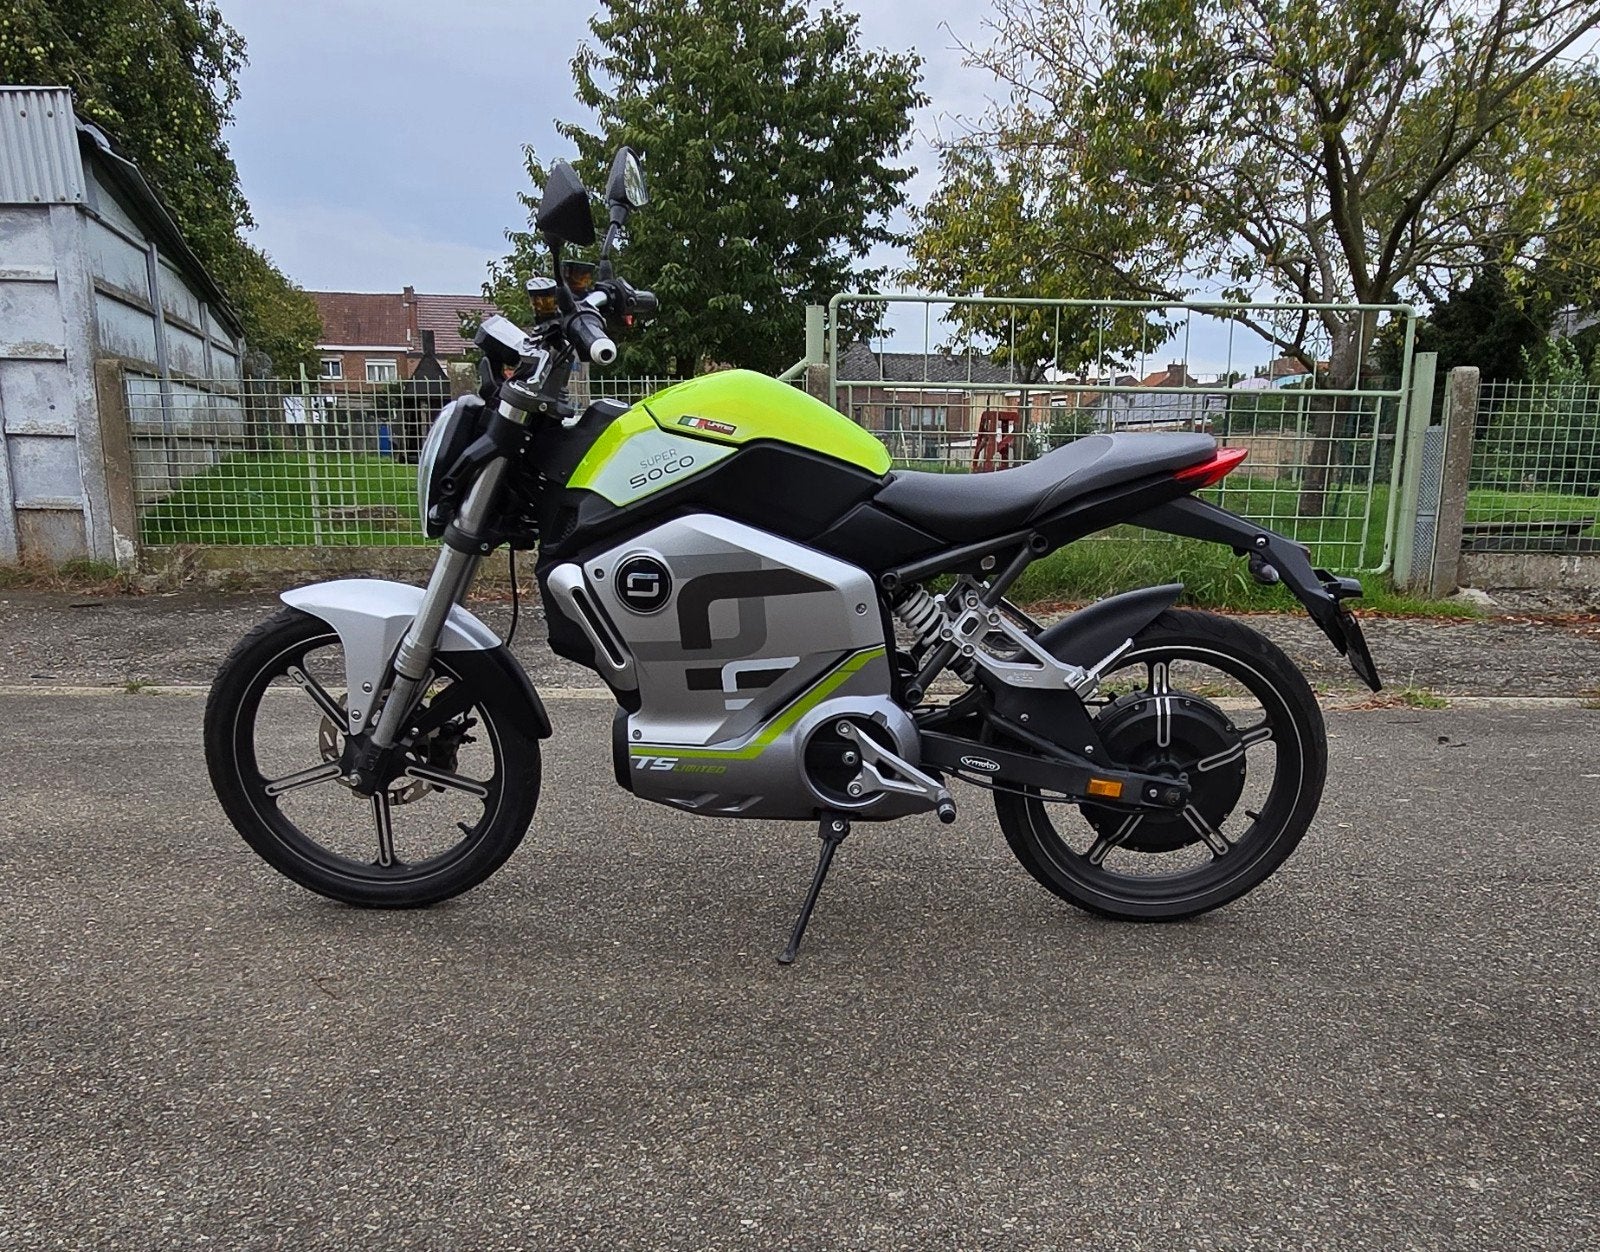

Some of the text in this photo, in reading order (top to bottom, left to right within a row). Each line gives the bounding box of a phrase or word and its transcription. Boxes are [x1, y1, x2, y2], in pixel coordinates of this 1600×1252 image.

[640, 448, 678, 469] SUPER
[630, 455, 694, 489] SOCO
[630, 755, 728, 775] TS LIMITED
